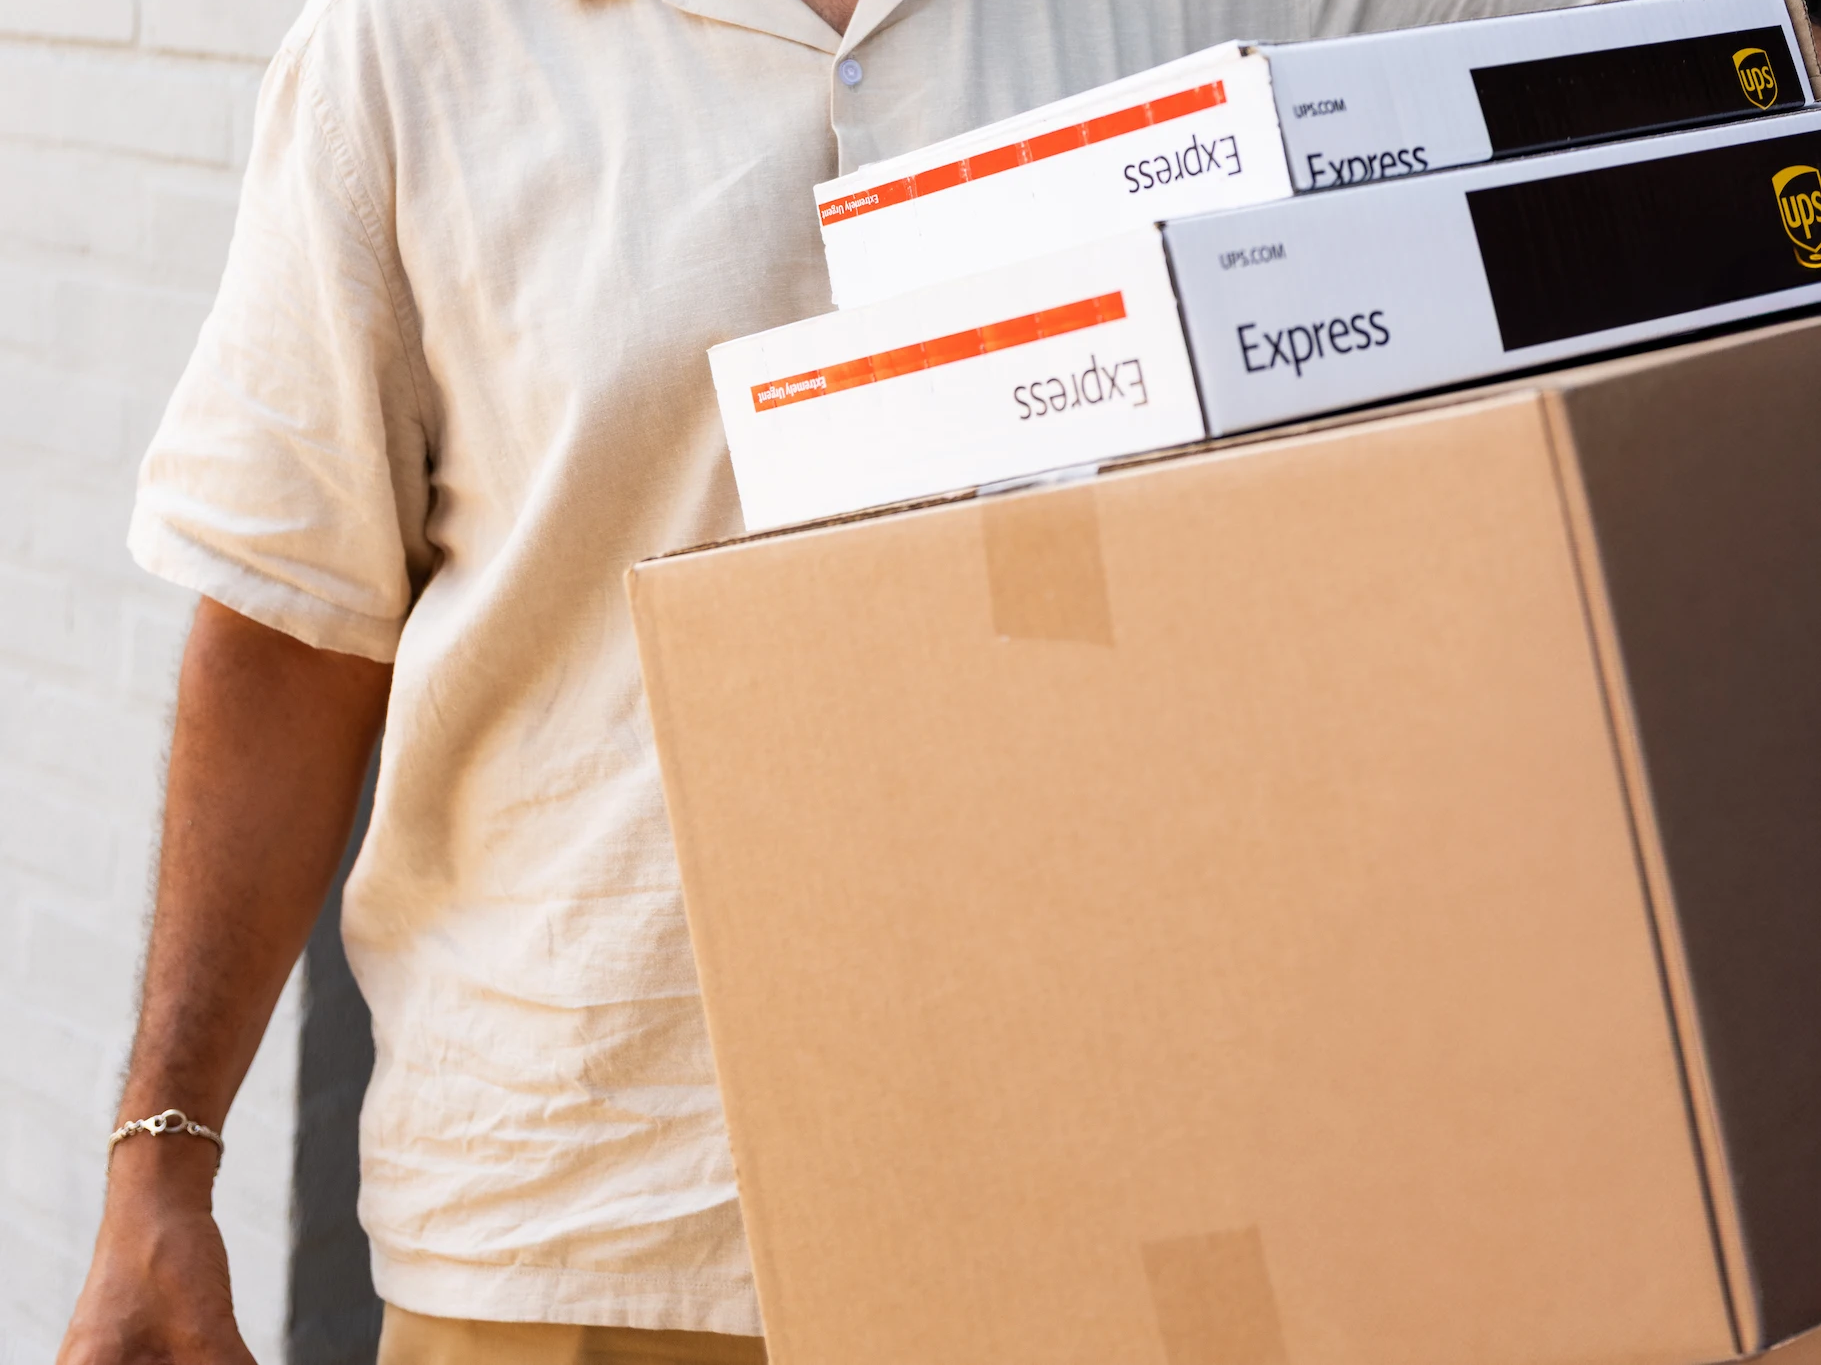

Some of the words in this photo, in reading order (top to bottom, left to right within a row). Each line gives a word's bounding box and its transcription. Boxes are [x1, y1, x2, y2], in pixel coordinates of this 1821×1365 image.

[1740, 66, 1774, 100] ups
[1293, 98, 1347, 119] UPS.COM
[1124, 134, 1242, 193] Express
[1307, 146, 1428, 189] Express
[821, 204, 844, 219] Urgent
[845, 194, 879, 212] Extremely
[1218, 242, 1287, 270] UPS.COM
[1237, 309, 1391, 377] Express
[757, 386, 785, 403] Urgent
[785, 376, 827, 397] Extremely
[1014, 354, 1148, 420] Express
